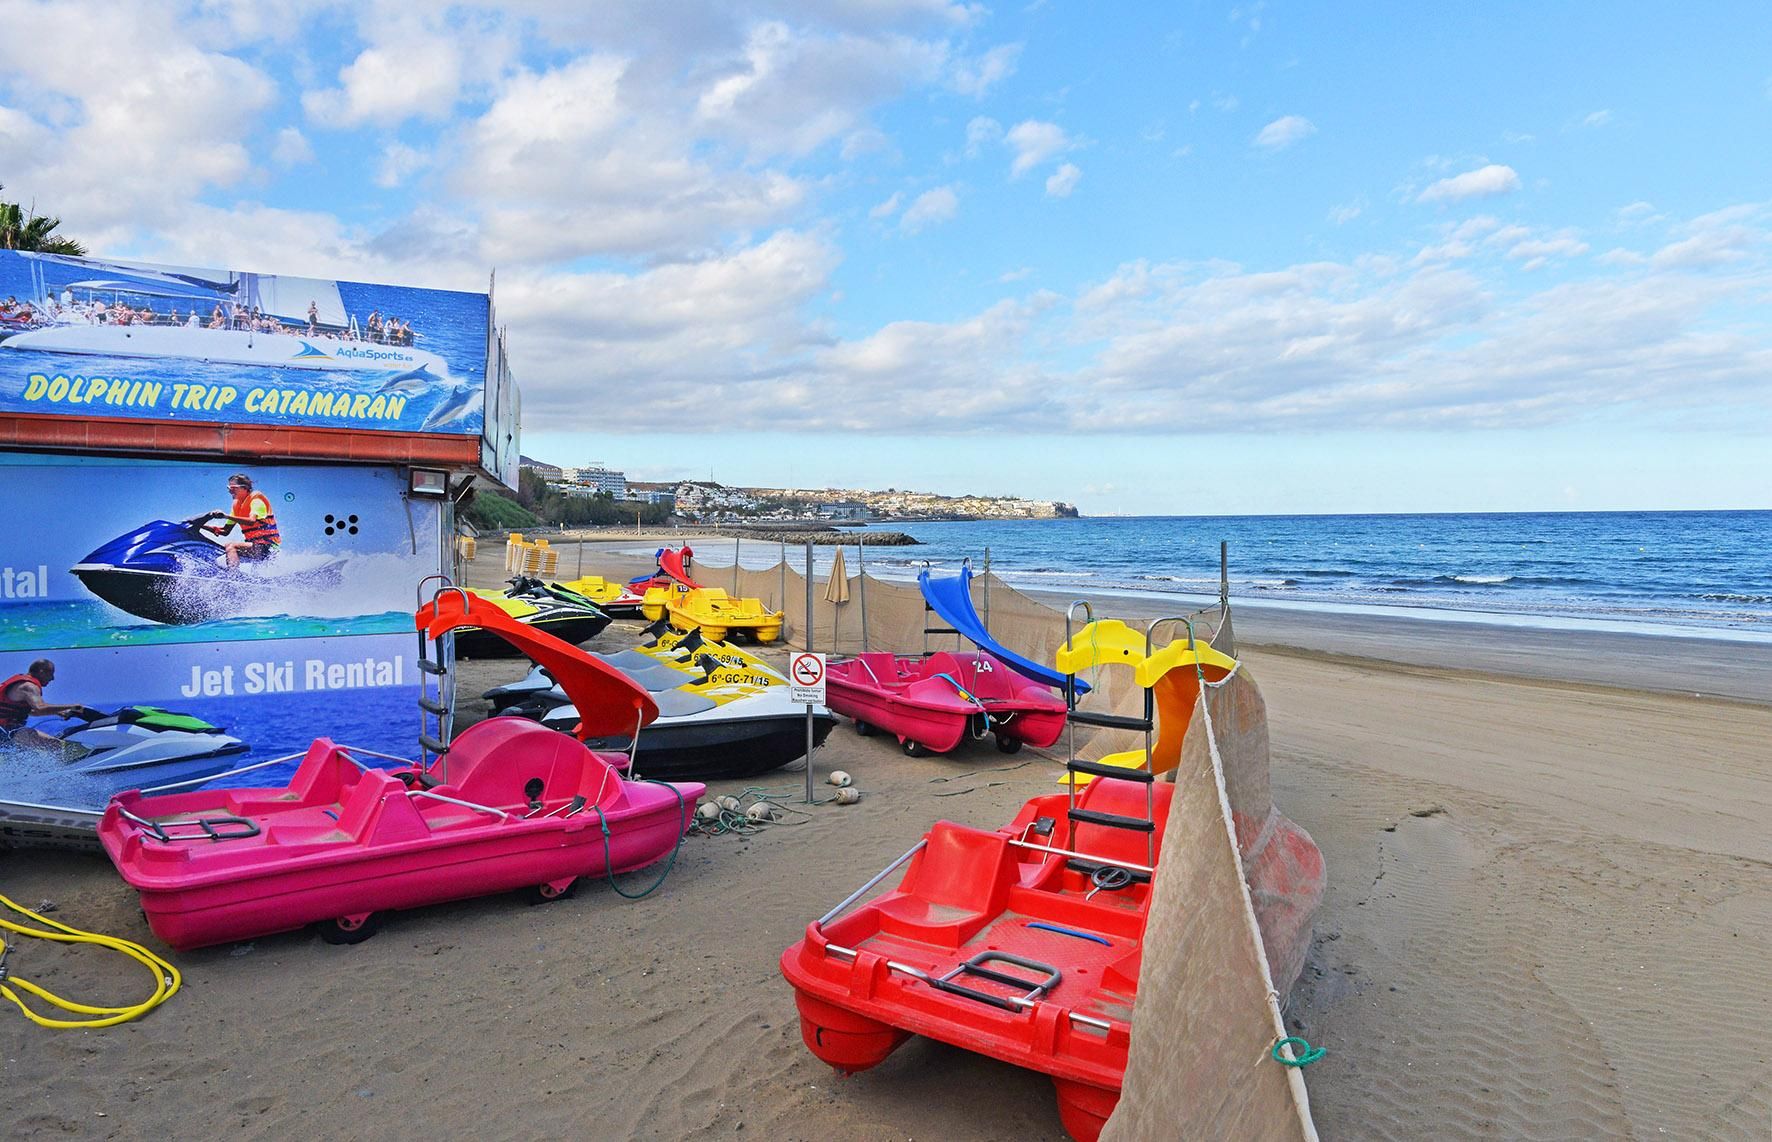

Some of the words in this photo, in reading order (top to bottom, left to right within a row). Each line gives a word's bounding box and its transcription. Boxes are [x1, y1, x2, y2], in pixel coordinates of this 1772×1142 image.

[24, 375, 162, 407] DOLPHIN
[170, 384, 237, 411] TRIP
[244, 388, 407, 420] CATAMARAN
[0, 565, 48, 598] tal
[181, 665, 234, 698] Jet
[244, 661, 294, 694] Ski
[305, 656, 402, 690] Rental
[972, 661, 993, 672] 24
